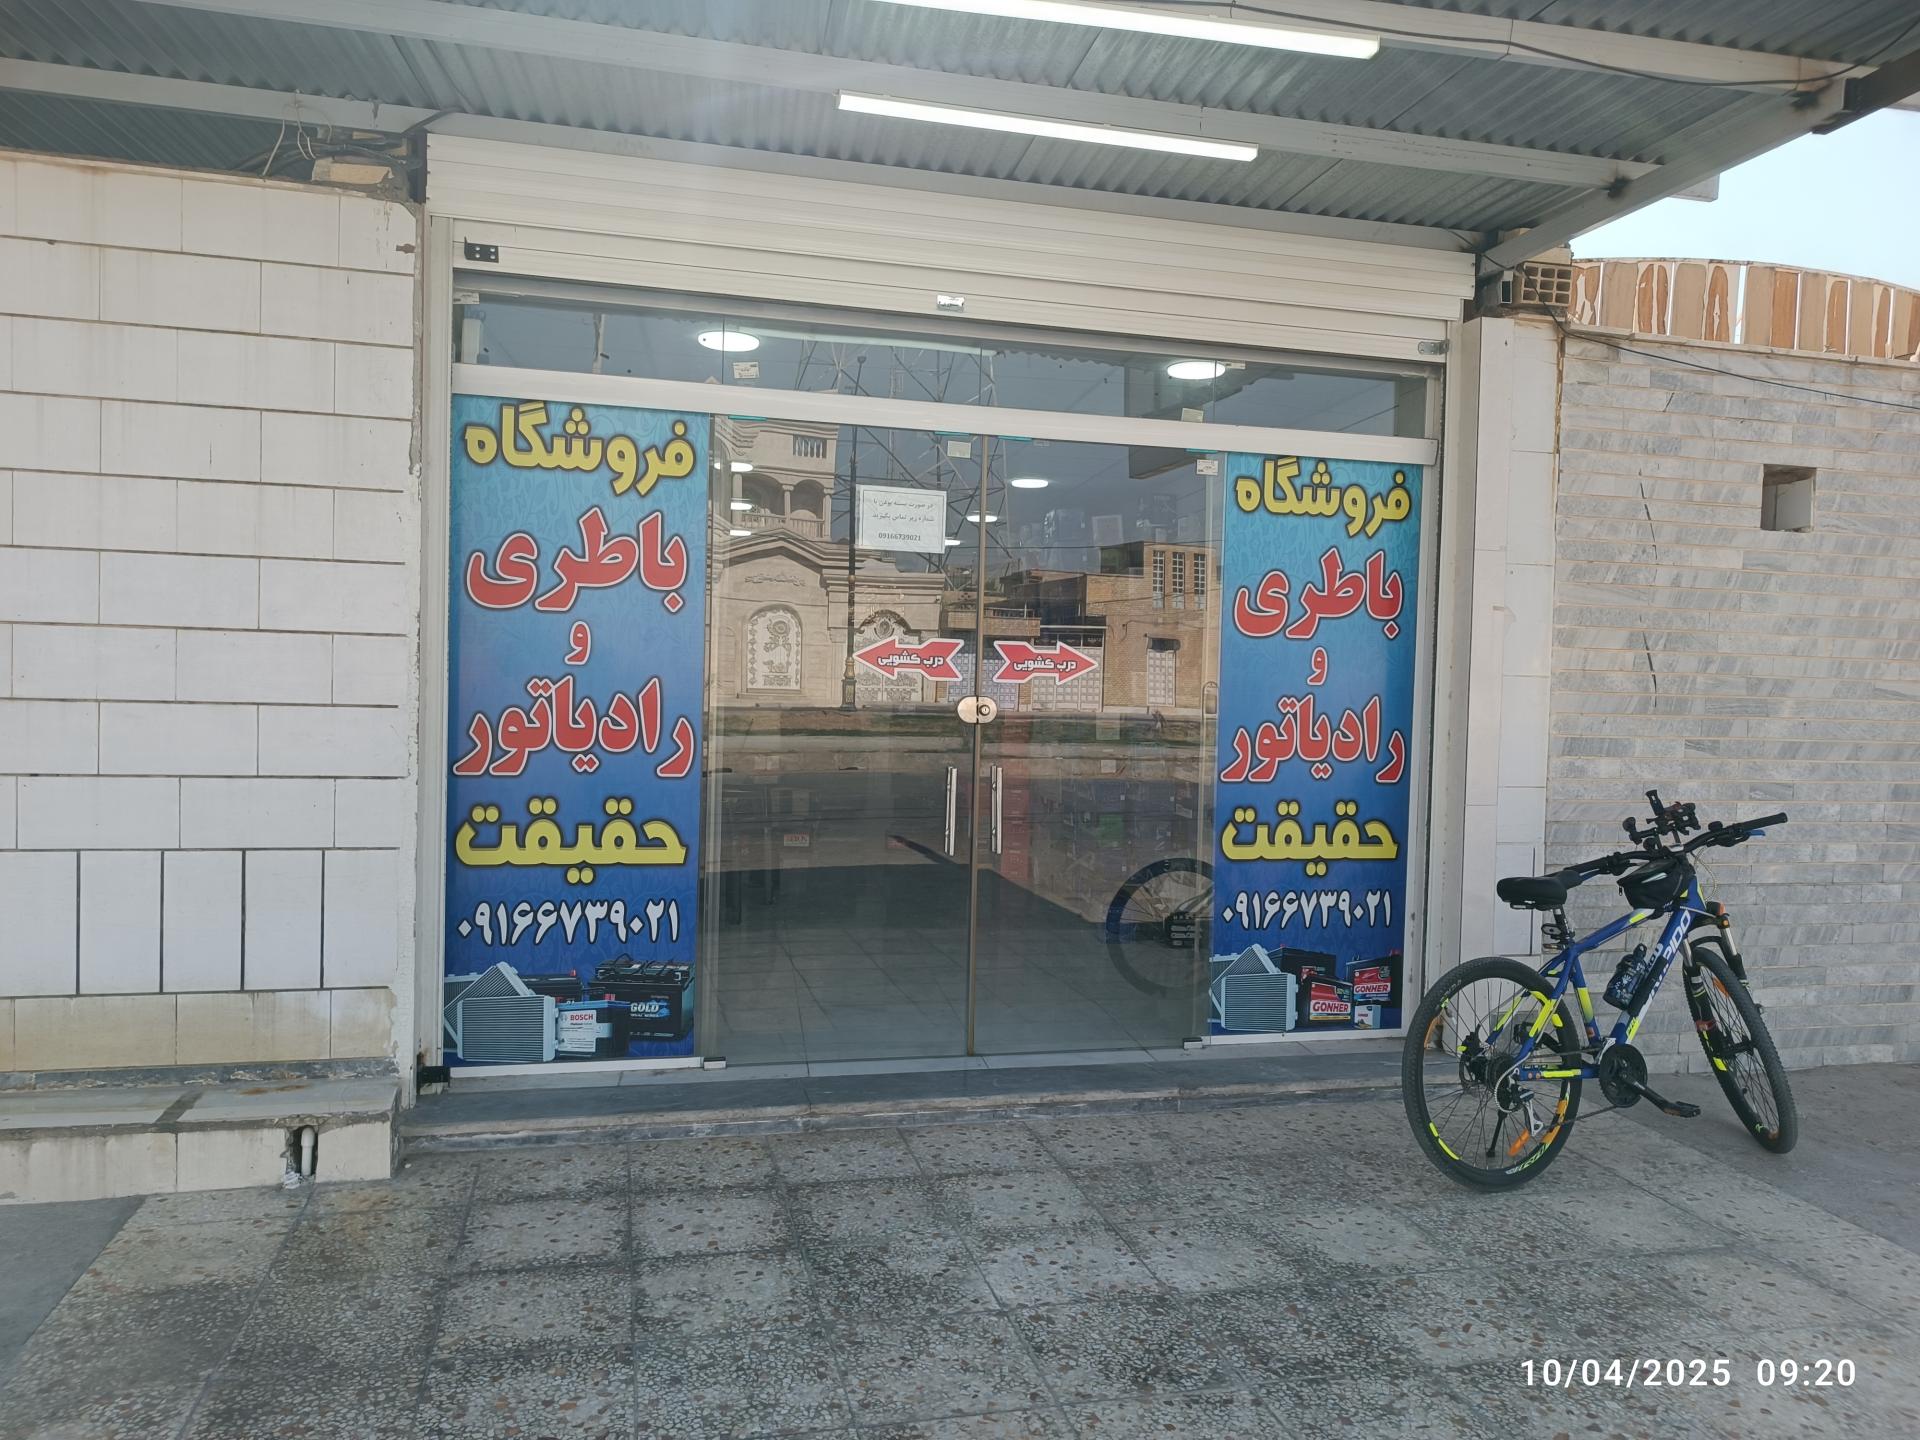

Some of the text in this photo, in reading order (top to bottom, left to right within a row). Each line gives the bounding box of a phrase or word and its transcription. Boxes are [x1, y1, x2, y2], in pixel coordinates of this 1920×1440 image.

[464, 400, 695, 497] فروشگاه
[1235, 456, 1411, 537] فروشگاه
[878, 532, 921, 541] 09166739021
[466, 506, 688, 613] باطری
[1234, 547, 1403, 639] باطری
[564, 620, 592, 666] و
[877, 649, 944, 668] درب کشویی
[1013, 655, 1077, 672] درب کشویی
[1307, 646, 1328, 685] و
[455, 798, 688, 884] حقیقت
[1221, 800, 1399, 877] حقیقت
[457, 900, 680, 945] ۰۹۱۶۶۷۳۹۰۲۱
[1222, 889, 1392, 929] ۰۹۱۶۶۷۳۹۰۲۱
[630, 1002, 659, 1013] GOLD
[1312, 1001, 1349, 1013] GONHER
[1354, 984, 1389, 993] GONHER
